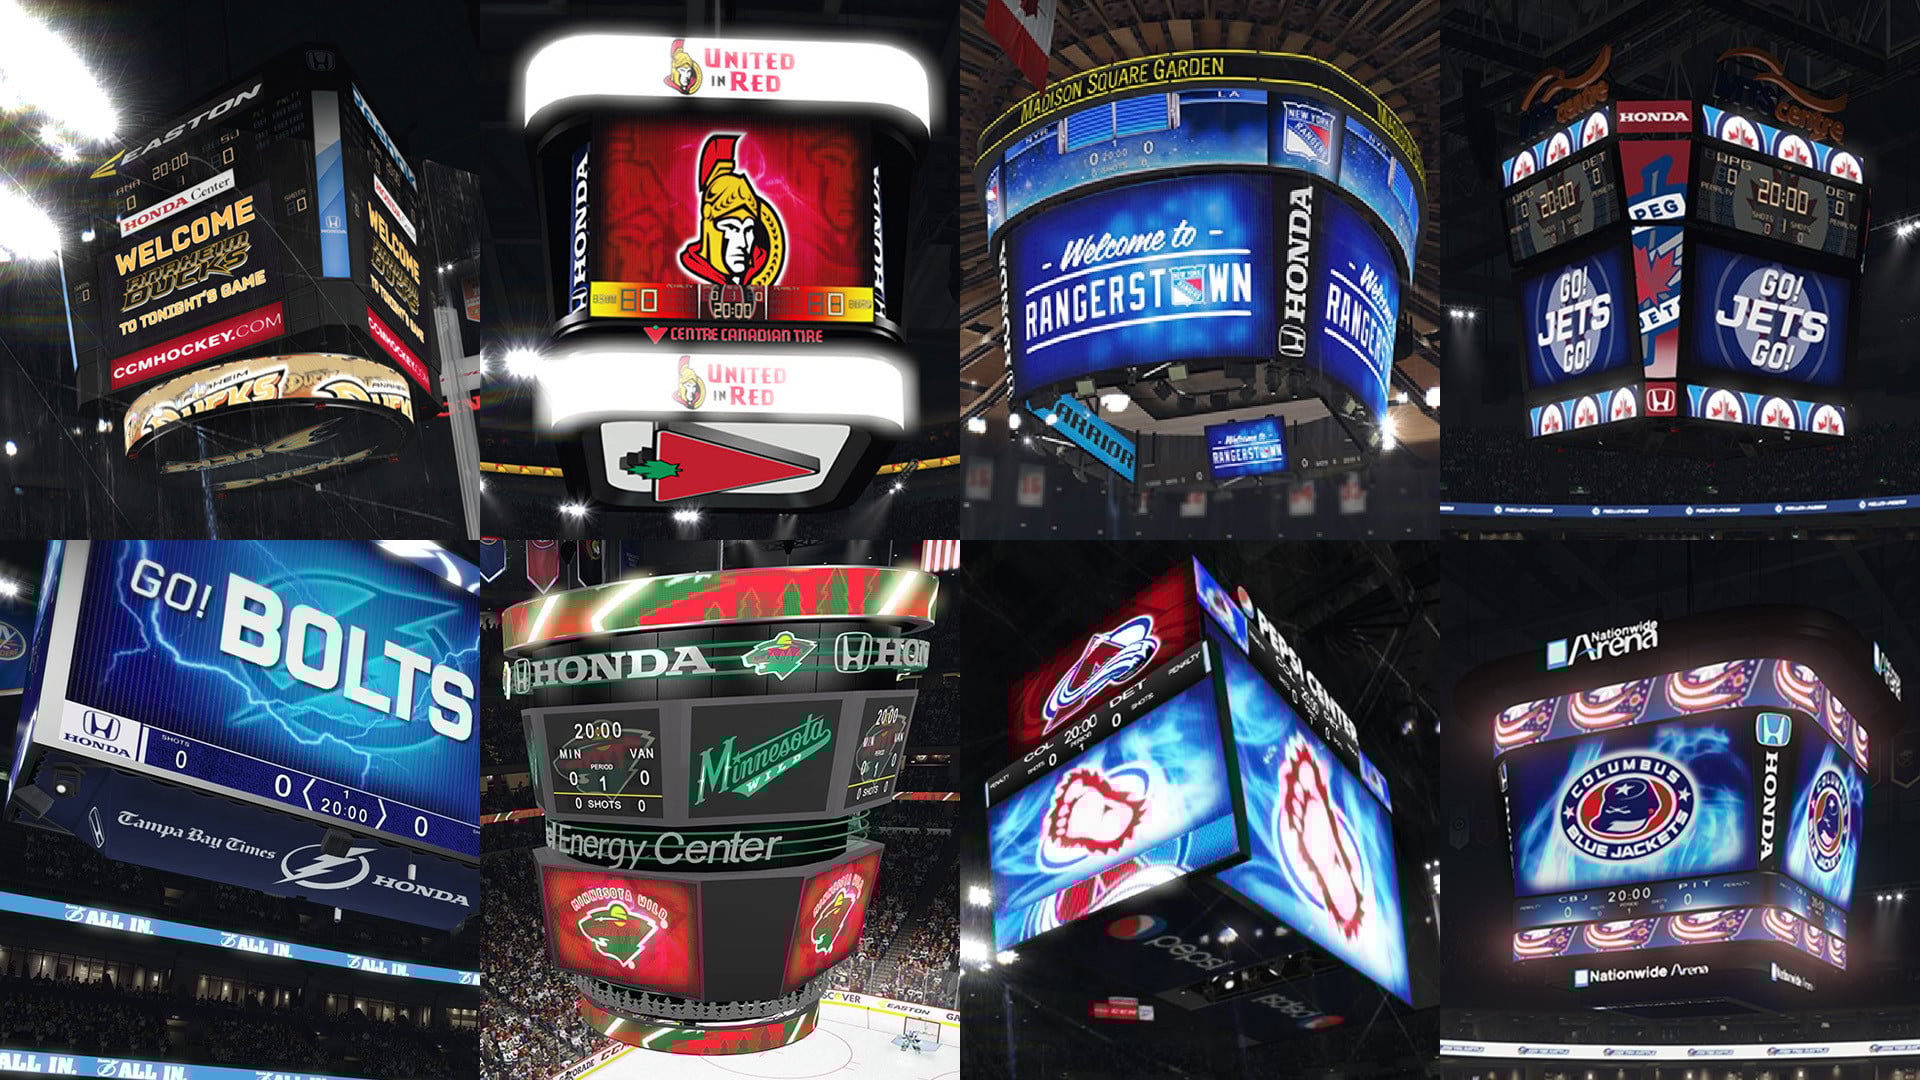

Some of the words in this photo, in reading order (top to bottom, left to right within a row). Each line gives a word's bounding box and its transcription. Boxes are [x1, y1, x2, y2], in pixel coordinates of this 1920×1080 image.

[705, 48, 795, 70] UNITED
[711, 75, 726, 87] IN
[730, 71, 781, 92] RED
[1020, 83, 1082, 124] MADISON
[1087, 63, 1148, 95] SQUARE
[1153, 57, 1224, 80] GARDEN
[1217, 90, 1241, 98] LA
[120, 83, 262, 166] EASTON
[1288, 109, 1308, 119] NEW
[1619, 111, 1690, 123] HONDA
[1775, 102, 1845, 145] centre
[223, 147, 235, 165] 0
[1143, 140, 1154, 154] 0
[152, 152, 189, 181] 20:00
[1089, 153, 1099, 166] 0
[1582, 152, 1607, 171] DET
[116, 178, 141, 196] ANA
[1592, 168, 1601, 185] 0
[1727, 168, 1738, 185] 0
[127, 195, 137, 211] 0
[1540, 181, 1576, 219] 20:00
[1757, 178, 1809, 215] 20:00
[1825, 184, 1857, 202] DET
[124, 197, 189, 232] HONDA
[190, 178, 231, 201] Center
[297, 196, 307, 212] 0
[1520, 202, 1529, 218] 0
[1634, 199, 1679, 221] PEG
[1835, 200, 1844, 216] 0
[115, 196, 256, 276] WELCOME
[367, 201, 420, 286] WELCOME
[1060, 229, 1166, 271] Welcome
[1171, 220, 1197, 247] to
[1284, 185, 1314, 323] HONDA
[120, 243, 252, 311] DUCKS
[1560, 265, 1588, 302] GO!
[1760, 268, 1804, 302] GO!
[119, 318, 138, 336] TO
[139, 288, 217, 329] TONIGHT'S
[221, 269, 266, 299] GAME
[713, 303, 751, 319] 20:00
[1537, 293, 1611, 347] JETS
[1715, 294, 1829, 343] JETS
[670, 327, 719, 342] CENTRE
[721, 327, 792, 343] CANADIAN
[793, 329, 823, 343] TIRE
[113, 313, 282, 379] CCMHOCKEY.COM
[1563, 339, 1590, 373] GO!
[1750, 339, 1795, 371] GO!
[708, 363, 787, 384] UNITED
[713, 390, 726, 401] IN
[730, 386, 774, 406] RED
[130, 558, 213, 619] GO!
[1591, 620, 1658, 642] Nationwide
[219, 572, 475, 742] BOLTS
[1568, 628, 1658, 666] Arena
[532, 646, 716, 688] HONDA
[1257, 607, 1305, 683] PEPSI
[1306, 670, 1360, 747] CENTER
[1109, 678, 1147, 708] DET
[574, 721, 622, 740] 20:00
[1064, 714, 1098, 744] 20:00
[1112, 713, 1121, 727] 0
[63, 731, 132, 759] HONDA
[161, 734, 190, 747] SHOTS
[175, 750, 188, 770] 0
[560, 749, 581, 760] MIN
[630, 748, 654, 759] VAN
[695, 712, 830, 805] Minnesota
[891, 753, 898, 767] 0
[1023, 742, 1055, 763] COL
[1048, 752, 1057, 767] 0
[640, 770, 650, 786] 0
[745, 753, 803, 792] WILD
[861, 760, 867, 775] 0
[873, 762, 879, 777] 1
[274, 773, 292, 798] 0
[569, 771, 578, 786] 0
[600, 776, 607, 791] 1
[1570, 759, 1681, 799] COLUMBUS
[343, 789, 350, 800] 1
[857, 787, 862, 800] 0
[883, 781, 889, 793] 0
[321, 798, 368, 824] 20:00
[575, 797, 583, 809] 0
[588, 800, 622, 810] SHOTS
[638, 800, 646, 812] 0
[1760, 751, 1778, 862] HONDA
[117, 810, 183, 840] Tampa
[187, 826, 222, 850] Bay
[225, 837, 276, 860] Times
[413, 815, 429, 837] 0
[1566, 824, 1608, 857] BLUE
[1611, 809, 1689, 858] JACKETS
[559, 824, 648, 870] Energy
[654, 831, 782, 865] Center
[372, 874, 470, 908] HONDA
[1608, 887, 1651, 903] 20:00
[1678, 880, 1711, 890] PIT
[570, 887, 633, 911] MINNESOTA
[637, 893, 668, 919] WILD
[1558, 895, 1588, 903] CBJ
[1684, 892, 1692, 905] 0
[85, 910, 124, 930] ALL
[130, 918, 154, 935] IN.
[1564, 906, 1572, 919] 0
[236, 937, 269, 954] ALL
[273, 943, 293, 958] IN.
[1143, 935, 1236, 971] pepsi
[361, 959, 388, 974] ALL
[392, 963, 410, 977] IN.
[1589, 966, 1667, 983] Nationwide
[1670, 963, 1709, 978] Arena
[887, 1003, 931, 1015] EASTON
[0, 1054, 41, 1073] ALL
[48, 1056, 77, 1075] IN.
[117, 1062, 158, 1080] ALL
